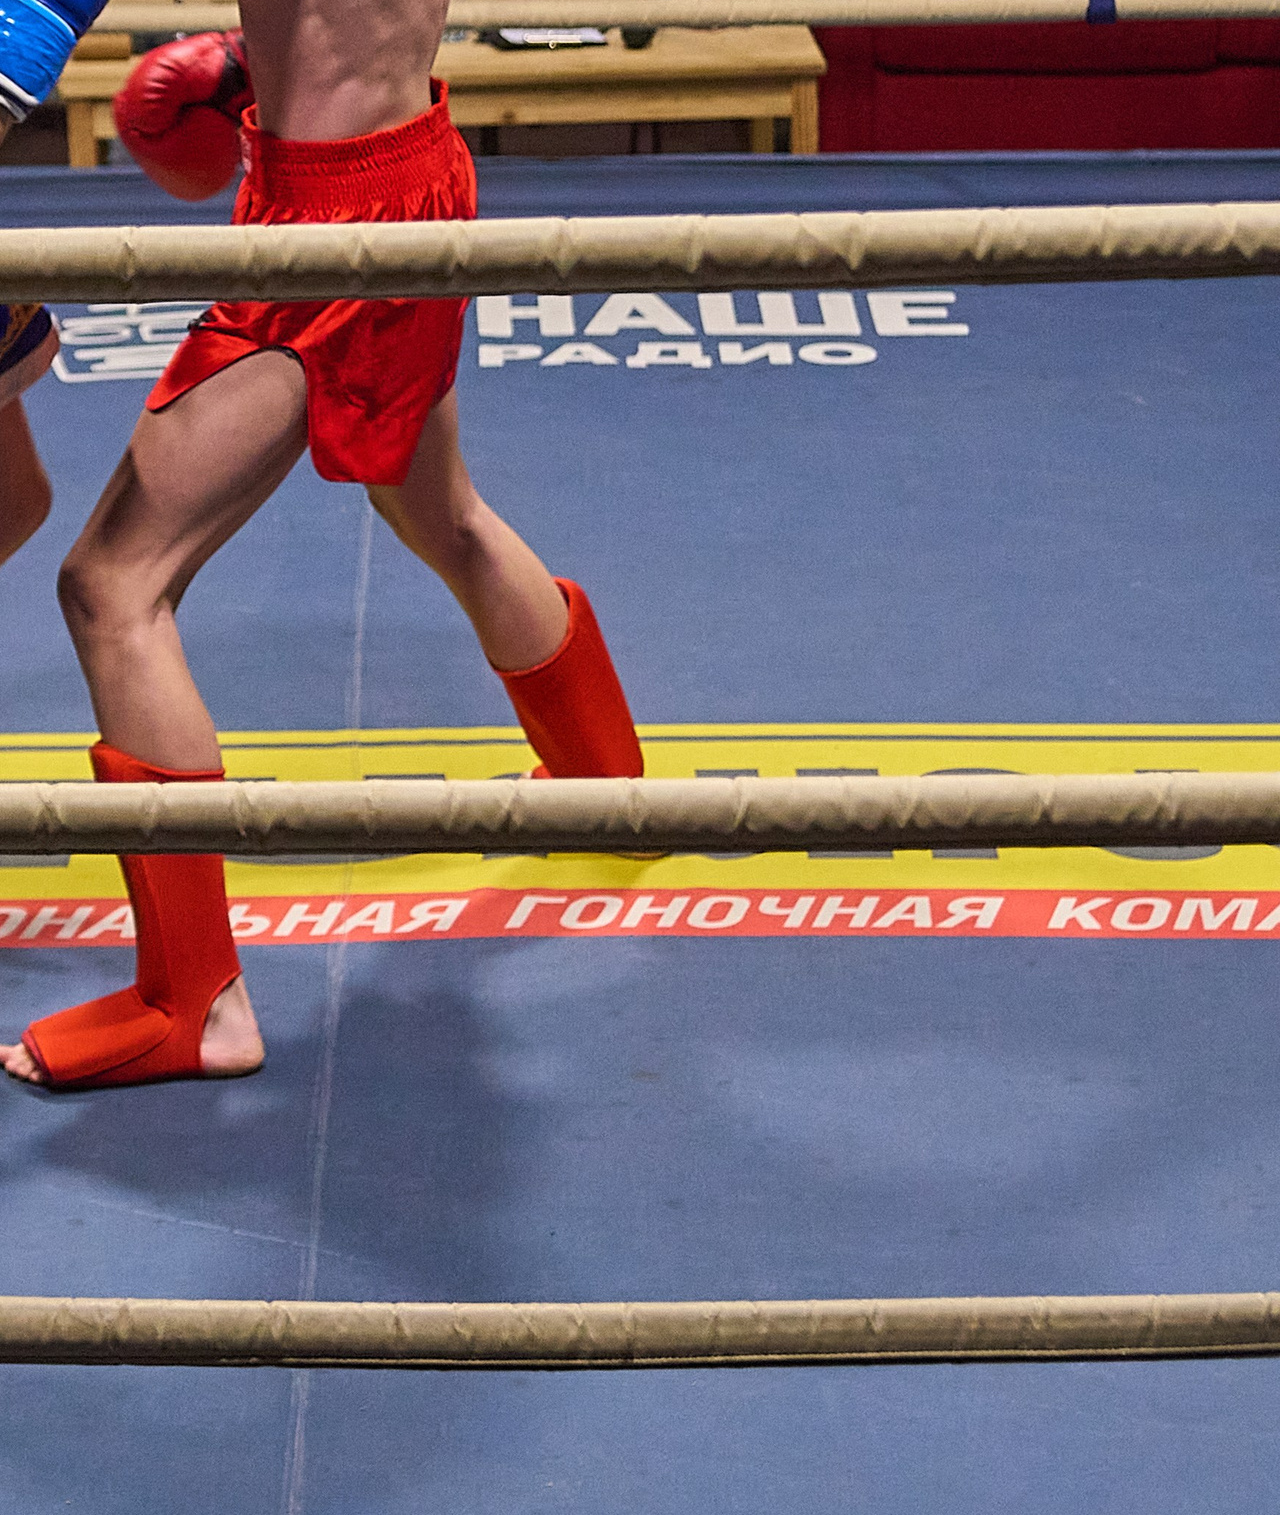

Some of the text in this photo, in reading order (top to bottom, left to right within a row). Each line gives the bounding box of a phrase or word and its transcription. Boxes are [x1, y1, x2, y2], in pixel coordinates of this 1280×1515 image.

[476, 291, 970, 337] НАШЕ
[478, 341, 879, 369] РАДИО
[505, 894, 1006, 930] ГОНОЧНАЯ
